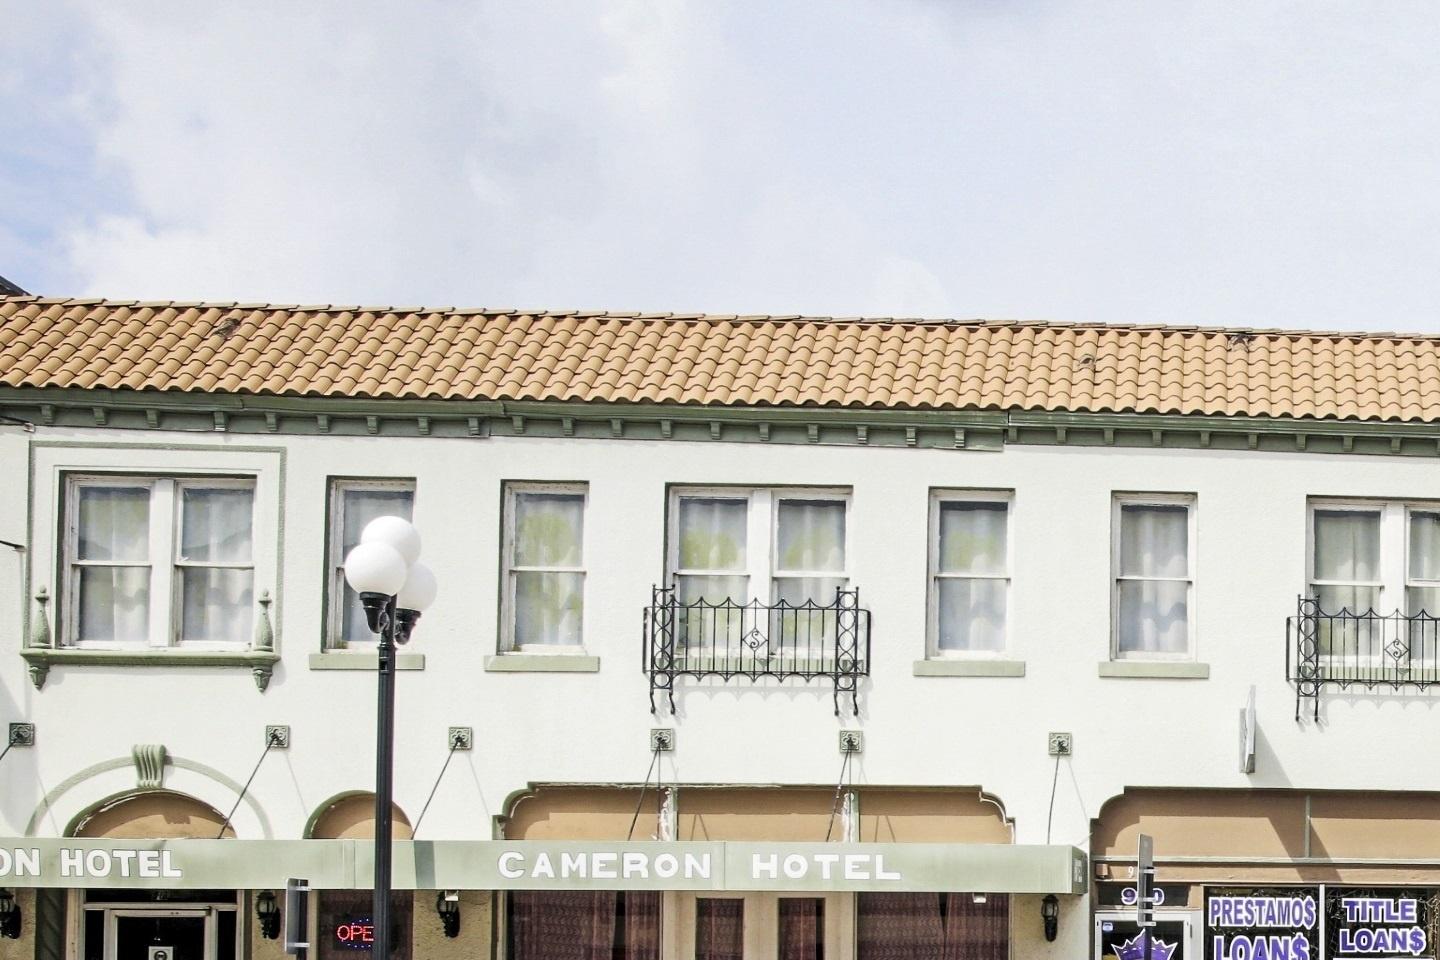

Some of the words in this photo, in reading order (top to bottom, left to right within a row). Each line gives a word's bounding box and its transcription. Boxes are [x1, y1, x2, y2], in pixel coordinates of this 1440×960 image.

[60, 848, 183, 878] HOTEL
[497, 851, 711, 880] CAMERON
[751, 852, 901, 881] HOTEL
[1121, 887, 1165, 905] 90
[1342, 898, 1417, 923] TITLE
[1209, 896, 1316, 930] PRESTAMO$
[337, 925, 374, 942] OPE
[1340, 926, 1426, 955] LOAN$
